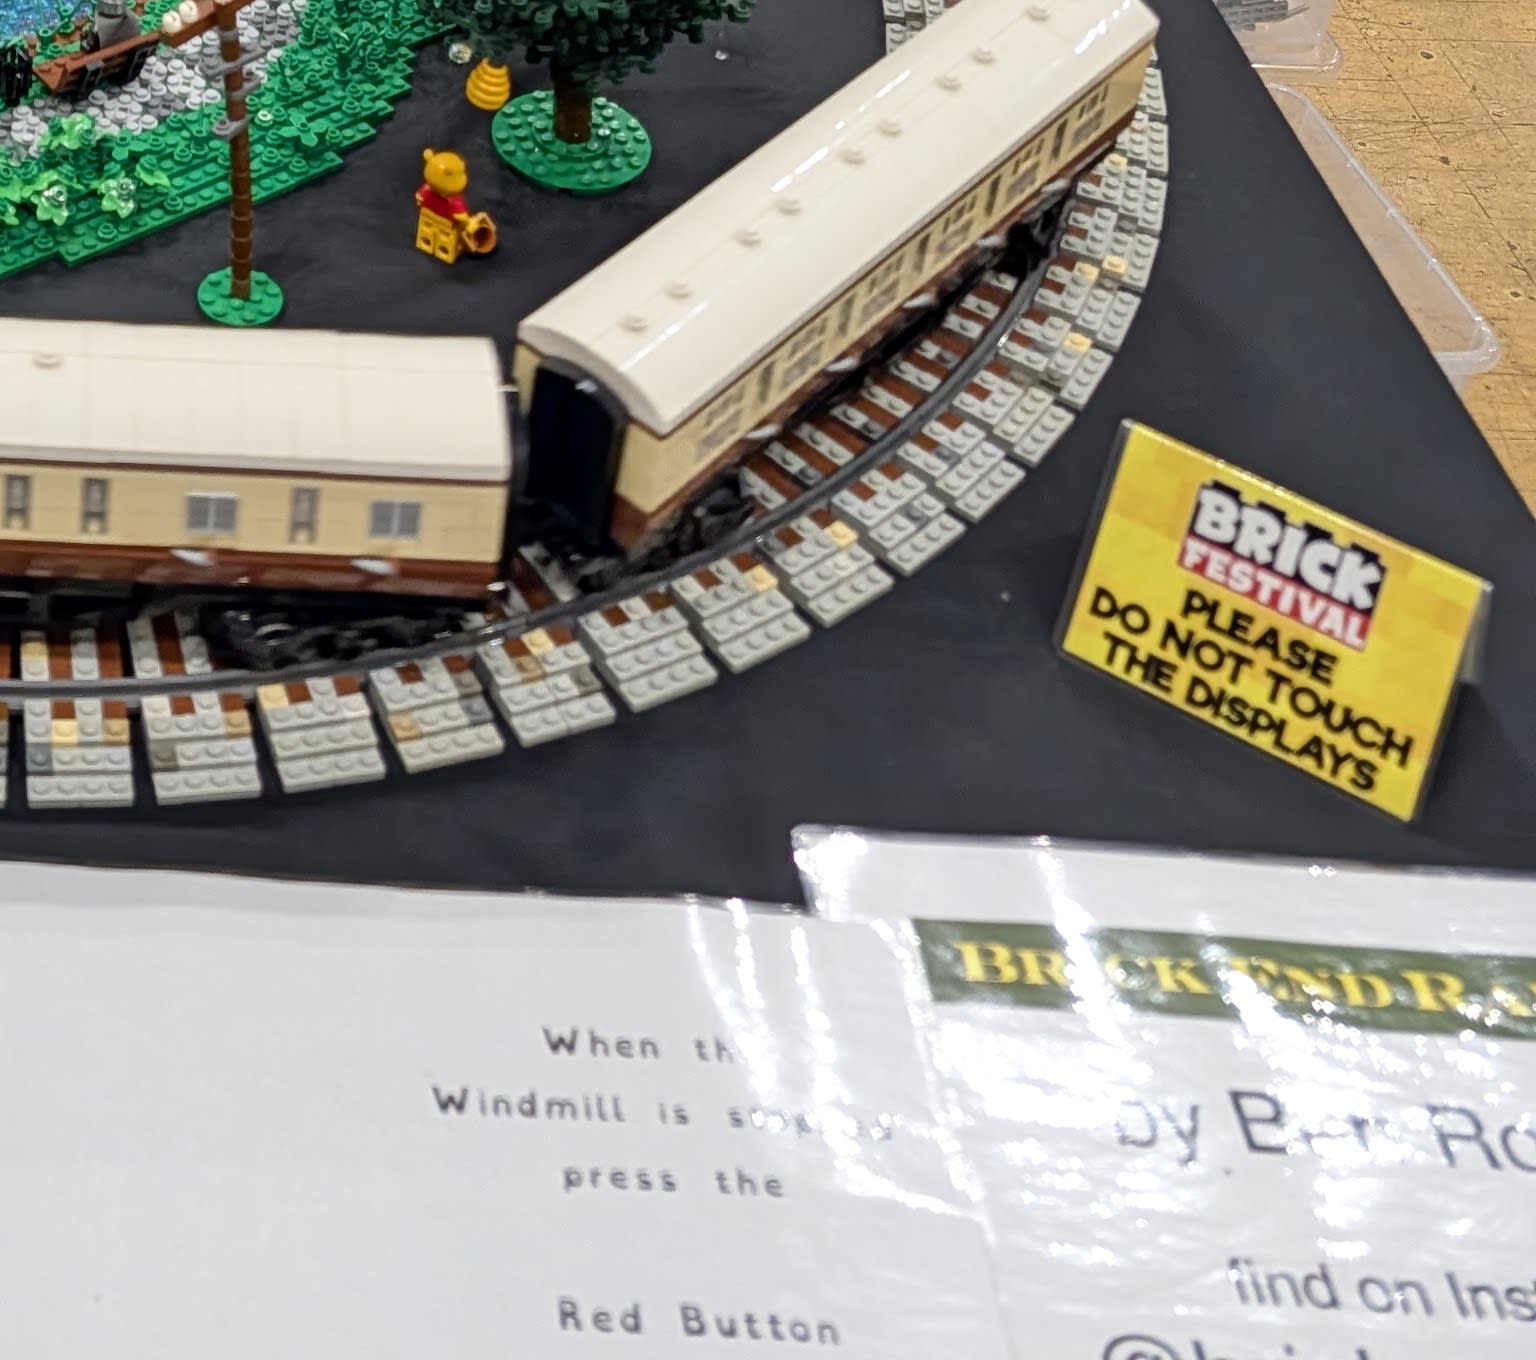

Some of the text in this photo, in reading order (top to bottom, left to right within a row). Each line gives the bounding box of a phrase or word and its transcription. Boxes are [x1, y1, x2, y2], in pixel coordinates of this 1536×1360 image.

[1196, 487, 1385, 611] BRICK
[1181, 540, 1369, 650] FESTIVAL
[1180, 590, 1339, 687] PLEASE
[1089, 587, 1414, 770] DO NOT TOUCH
[1102, 630, 1378, 793] THE DISPLAYS
[953, 940, 1213, 995] BRCK
[542, 1026, 735, 1063] When th
[431, 1085, 625, 1124] Windmill
[658, 1101, 691, 1127] is
[563, 1164, 785, 1199] press the
[558, 1295, 841, 1346] Red Button
[1357, 1276, 1434, 1317] on
[1444, 1271, 1536, 1323] Ins
